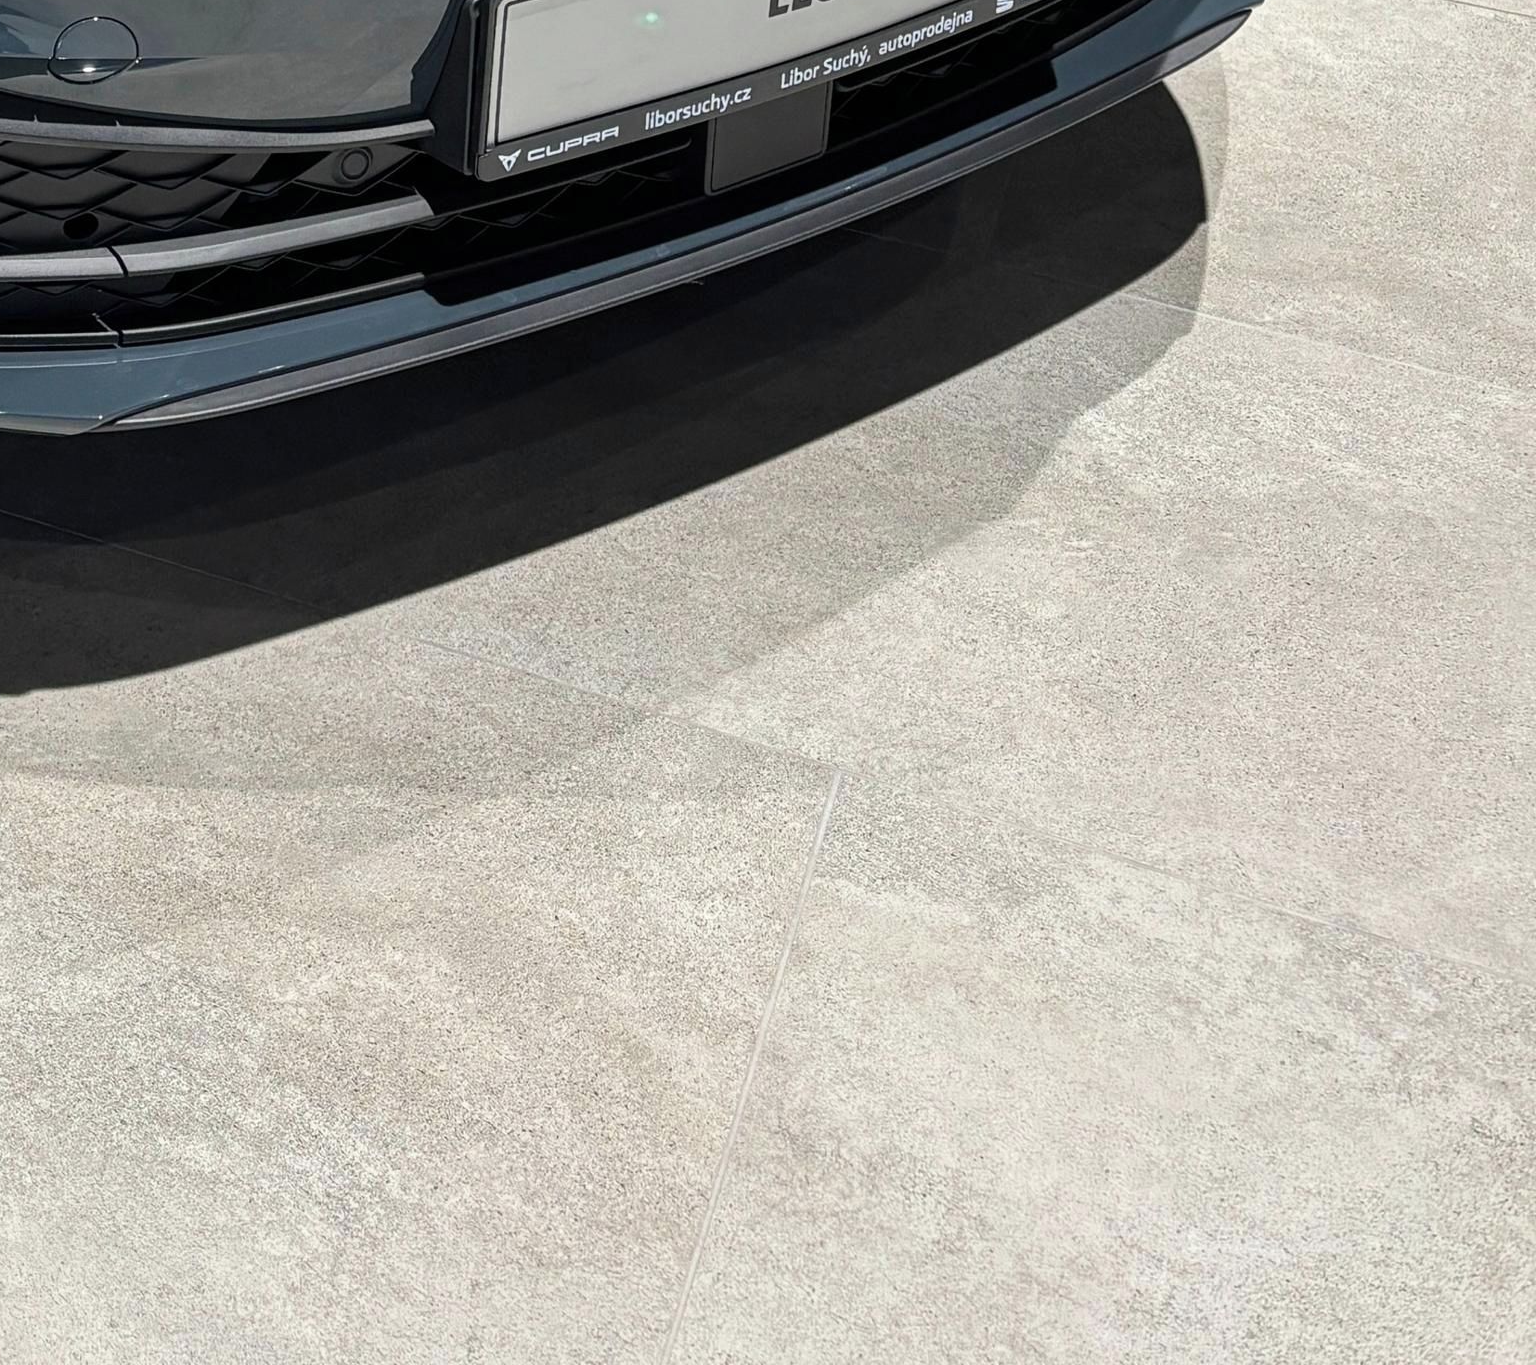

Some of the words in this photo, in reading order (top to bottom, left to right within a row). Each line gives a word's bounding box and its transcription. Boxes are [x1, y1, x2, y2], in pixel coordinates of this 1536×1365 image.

[780, 64, 821, 90] Libor
[822, 44, 872, 76] Suchý,
[878, 8, 974, 56] autoprodejna
[527, 125, 620, 162] CUPRA
[644, 86, 753, 131] liborsuchy.cz
